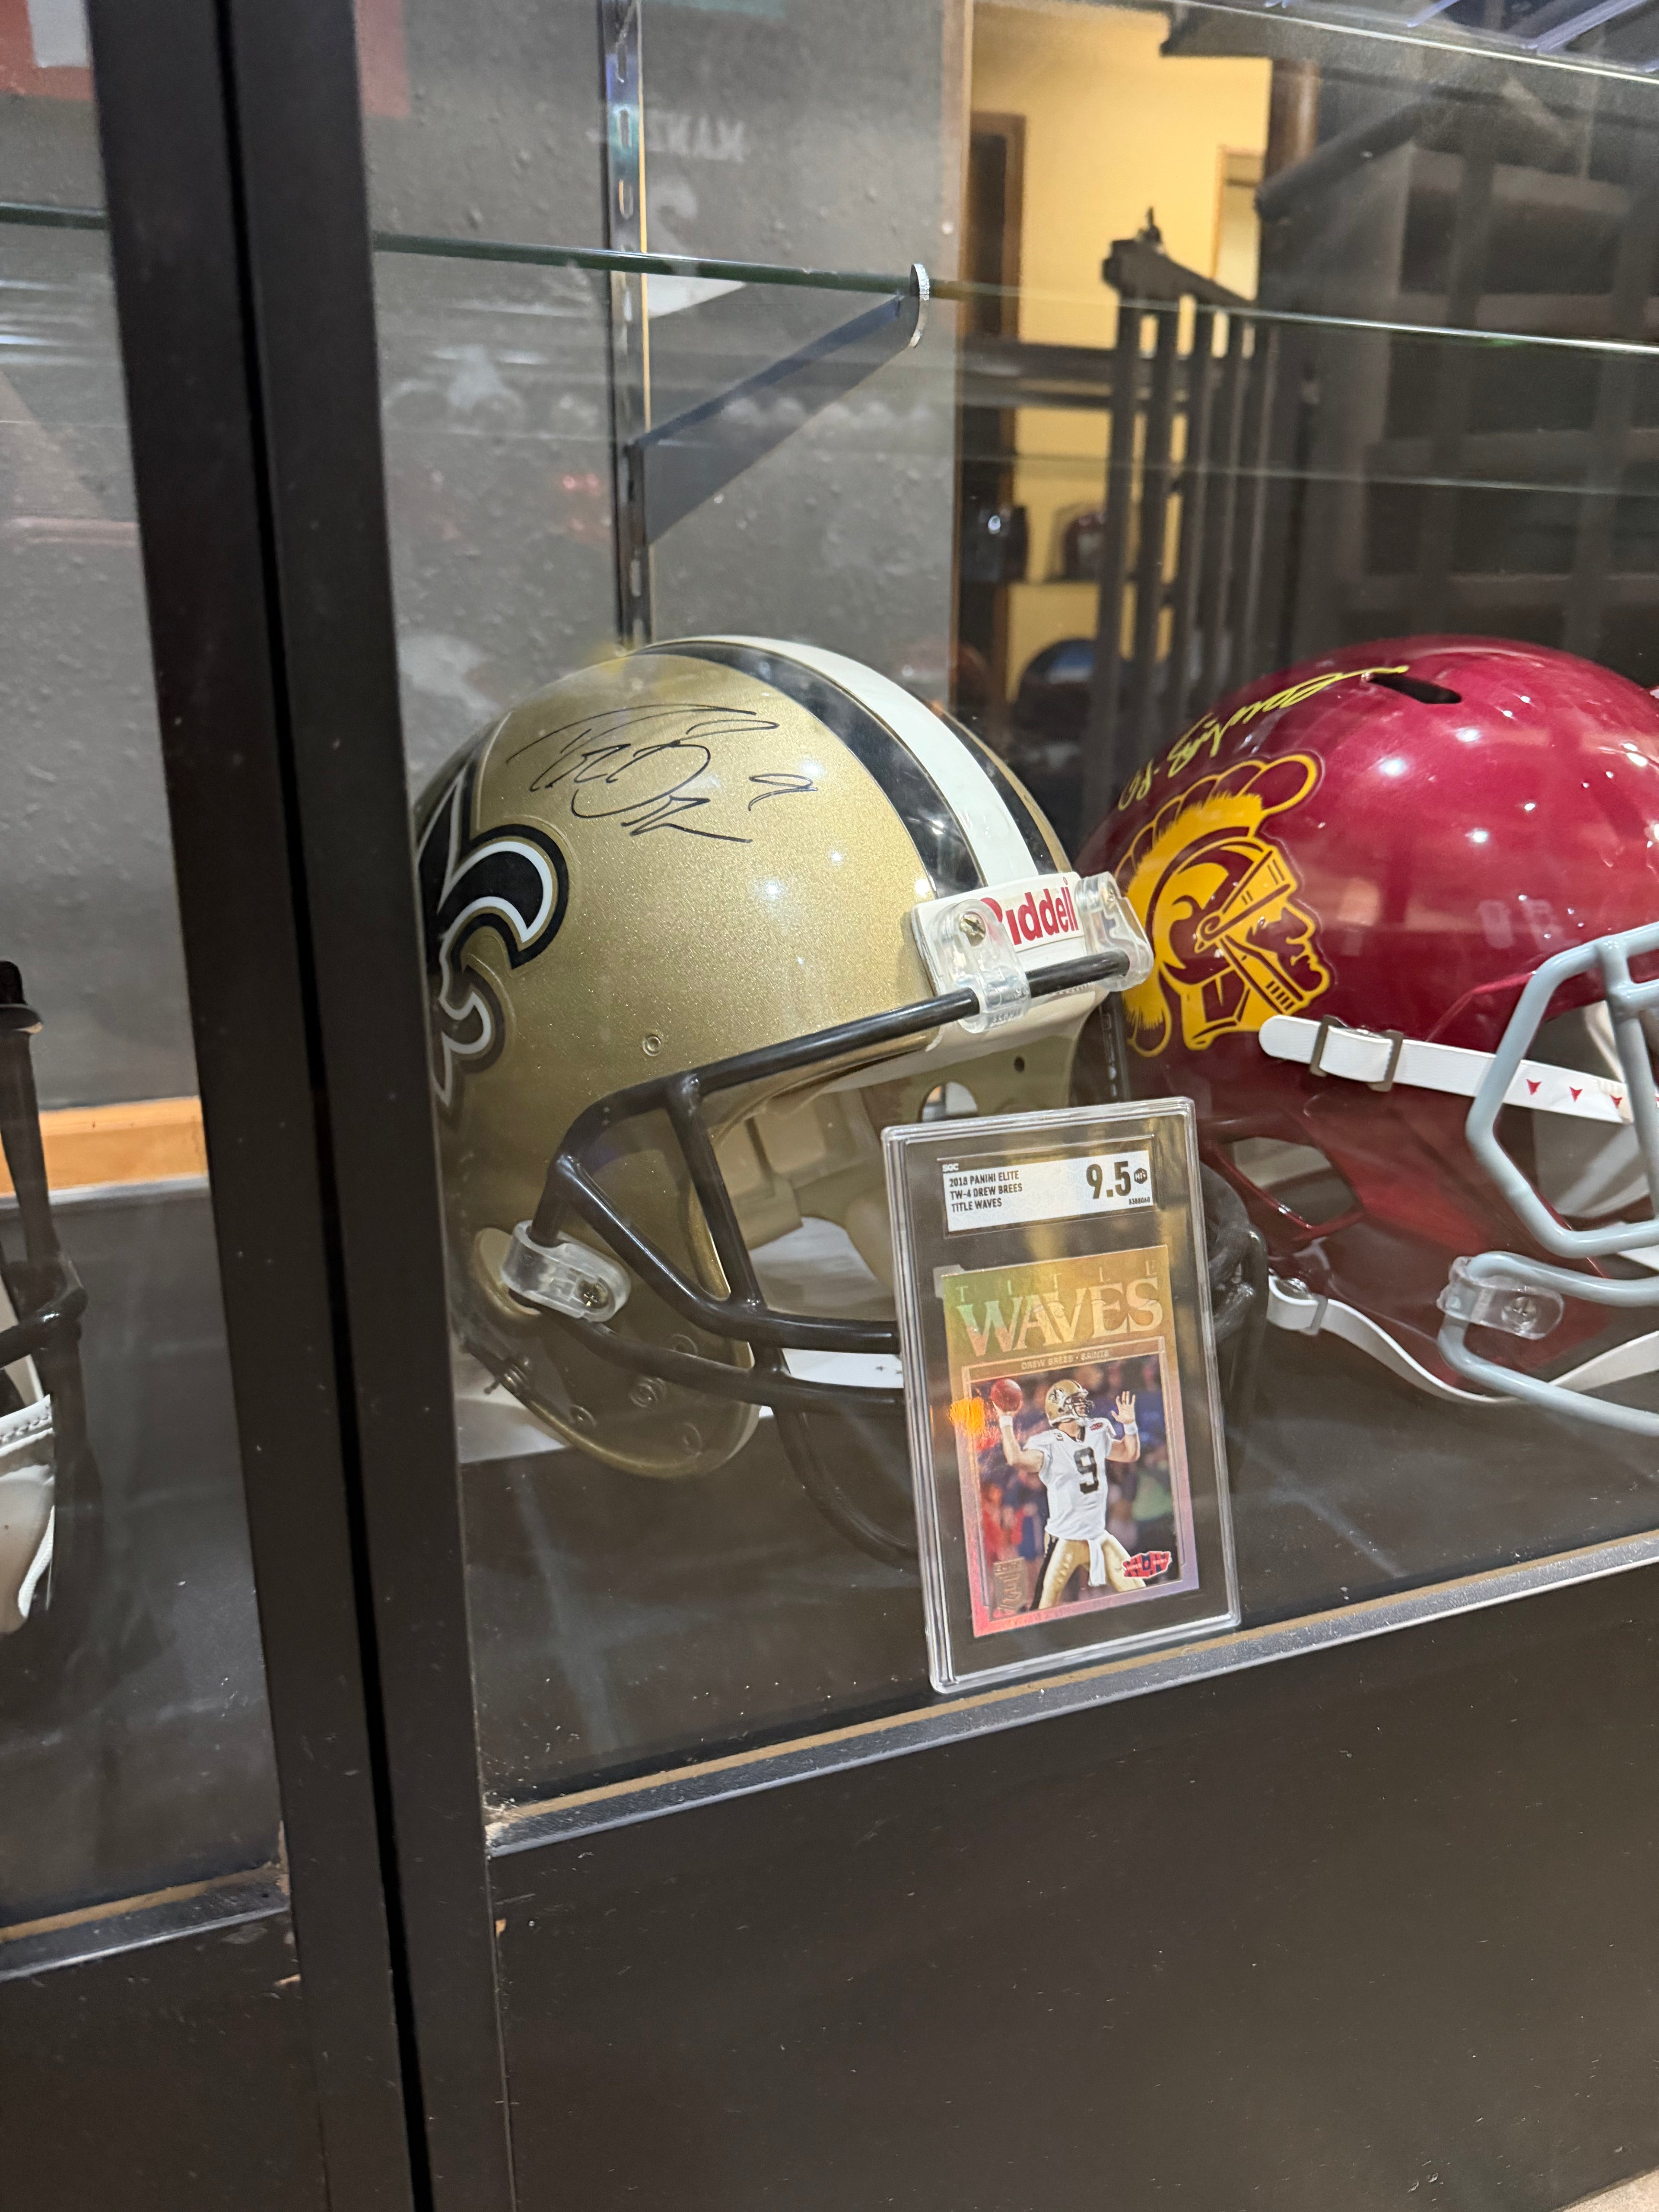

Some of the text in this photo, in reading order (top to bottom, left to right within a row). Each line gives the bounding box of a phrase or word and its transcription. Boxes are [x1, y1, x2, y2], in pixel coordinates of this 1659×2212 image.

[942, 1163, 959, 1172] SGC
[949, 1170, 1019, 1187] 2018 PANINI ELITE
[1086, 1161, 1131, 1199] 9.5
[950, 1183, 1023, 1200] TW-4 DREW BREES
[951, 1198, 1002, 1212] TITLE WAVES
[957, 1278, 1163, 1357] WAVES
[1021, 1359, 1046, 1370] DREW
[1074, 1447, 1099, 1494] 9
